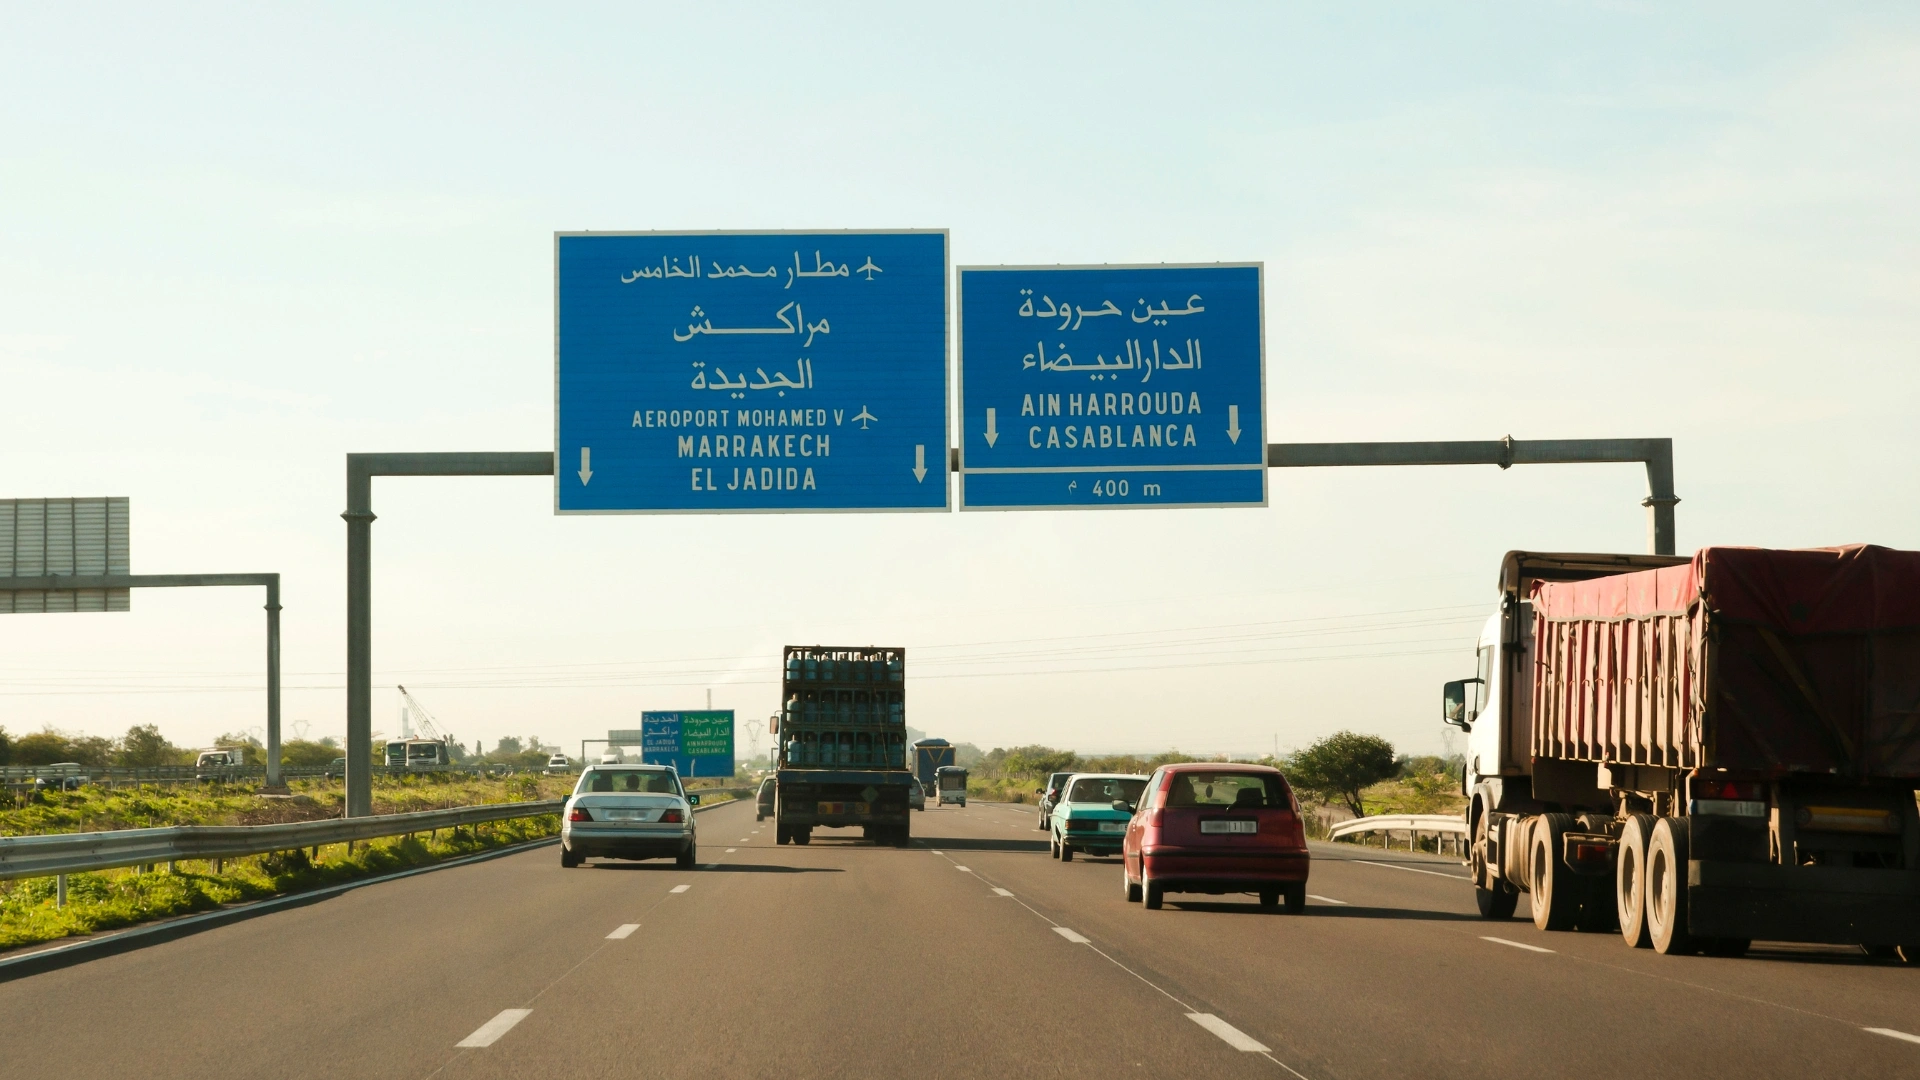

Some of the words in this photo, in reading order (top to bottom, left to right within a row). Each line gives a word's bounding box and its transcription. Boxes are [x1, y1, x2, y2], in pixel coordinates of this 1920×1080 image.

[621, 255, 701, 284] الخامس
[707, 261, 777, 279] محمد
[785, 250, 850, 289] مطار
[1018, 288, 1122, 331] حرودة
[1131, 294, 1205, 326] عين
[673, 301, 830, 347] مراكش
[691, 358, 813, 399] الجديدة
[1021, 393, 1060, 416] AIN
[1069, 391, 1201, 416] HARROUDA
[632, 410, 729, 427] AEROPORT
[737, 409, 826, 427] MOHAMED
[834, 409, 844, 426] V
[678, 434, 830, 458] MARRAKECH
[1029, 424, 1197, 449] CASABLANCA
[691, 468, 717, 491] EL
[727, 467, 817, 491] JADIDA
[1092, 479, 1129, 497] 400
[1143, 484, 1161, 496] m
[644, 713, 679, 725] الجديدة
[684, 715, 710, 726] حرودة
[712, 716, 729, 724] عين
[644, 726, 679, 738] مراكش
[655, 738, 676, 746] JADIDA
[643, 745, 679, 753] MARRAKECH
[687, 747, 726, 755] CASABLANCA
